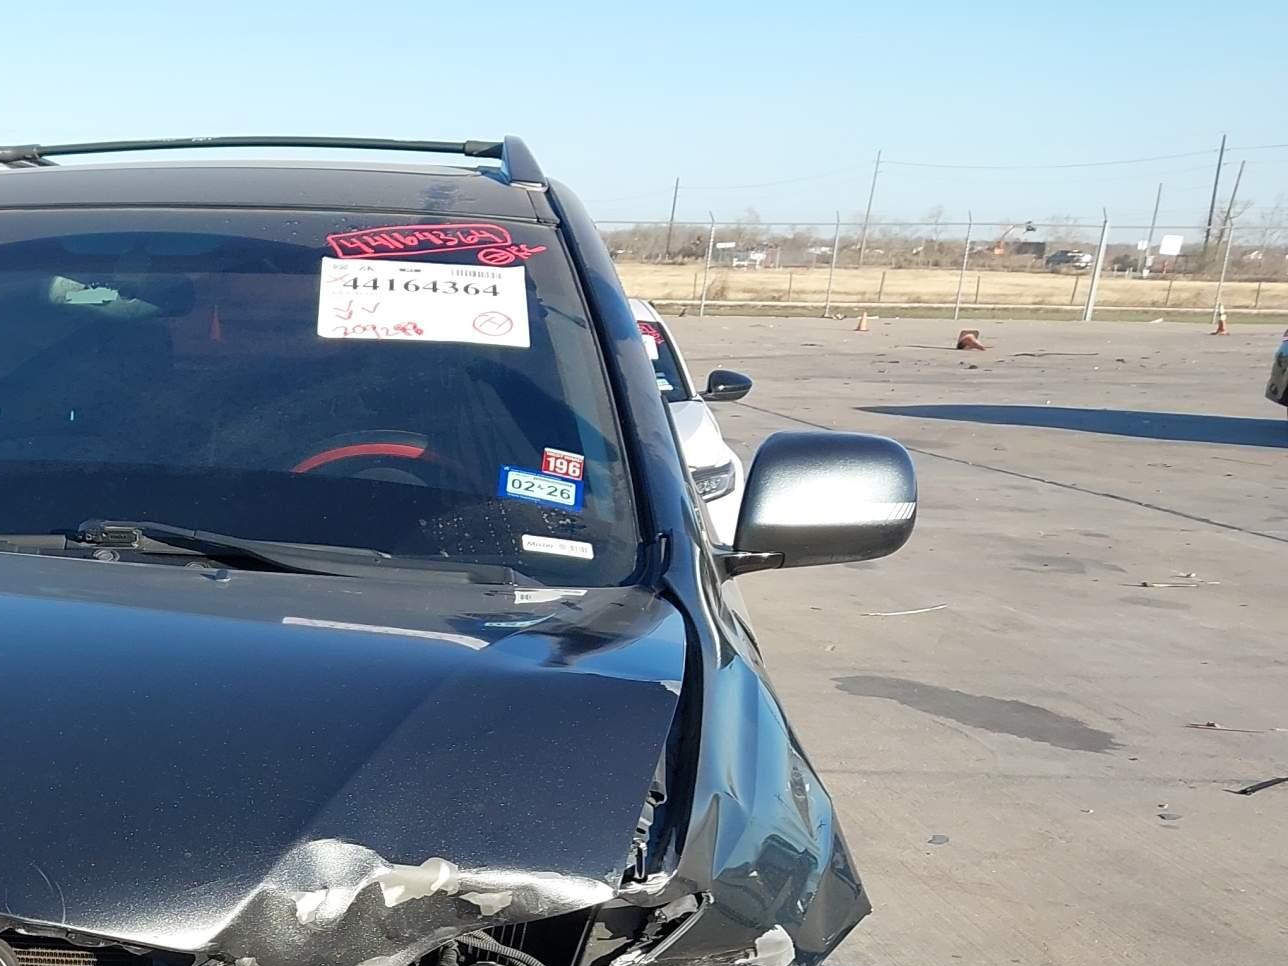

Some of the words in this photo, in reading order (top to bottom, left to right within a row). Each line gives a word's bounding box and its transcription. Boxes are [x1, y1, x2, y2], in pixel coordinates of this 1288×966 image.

[340, 229, 505, 255] 44164364
[341, 276, 501, 297] 44164364
[546, 456, 581, 477] 196
